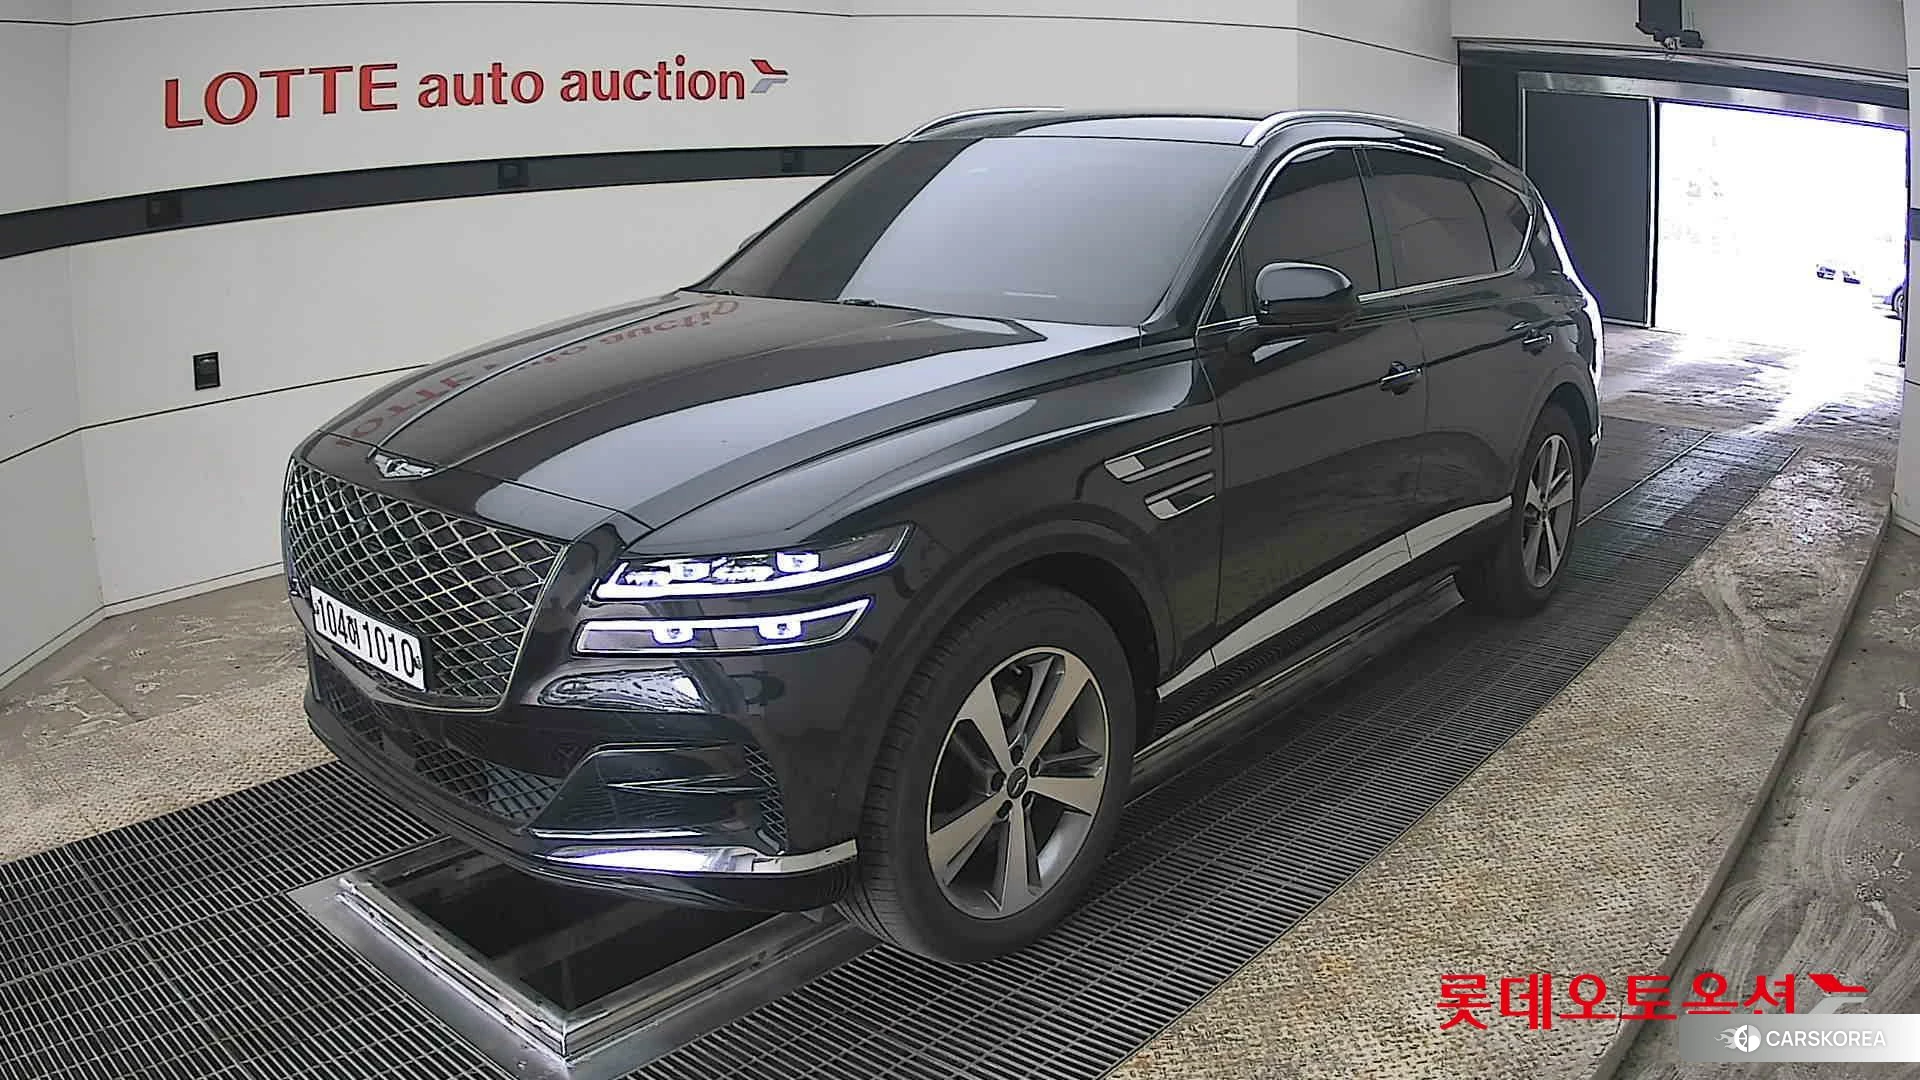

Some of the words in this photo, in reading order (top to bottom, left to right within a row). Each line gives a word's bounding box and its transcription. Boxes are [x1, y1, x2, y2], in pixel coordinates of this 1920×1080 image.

[164, 63, 399, 128] LOTTE
[419, 63, 544, 107] auto
[561, 55, 746, 101] auction
[318, 596, 361, 650] 104허
[362, 621, 415, 678] 1010
